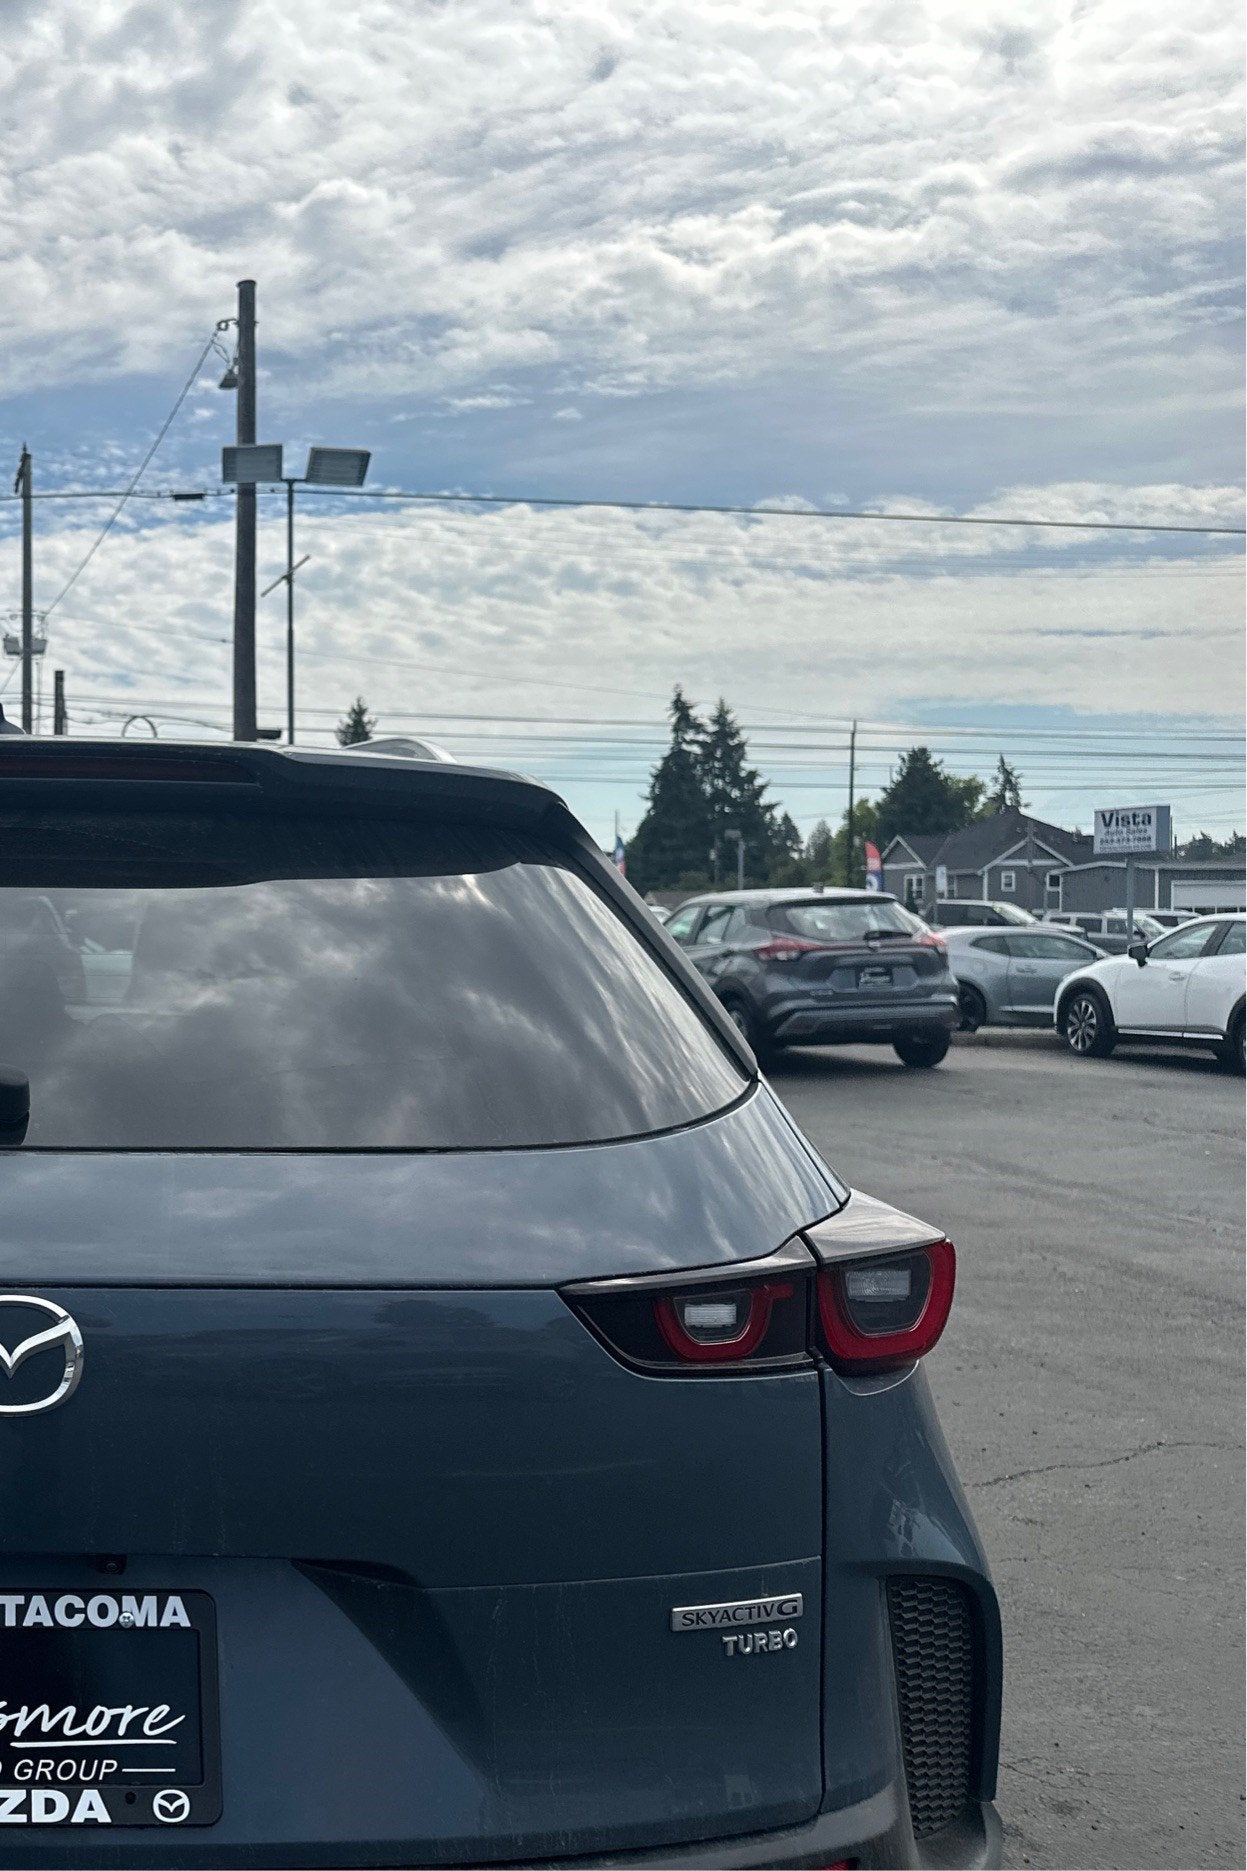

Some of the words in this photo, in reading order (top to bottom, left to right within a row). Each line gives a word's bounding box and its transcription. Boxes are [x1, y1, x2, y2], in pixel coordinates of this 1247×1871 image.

[1100, 811, 1152, 827] Vista
[722, 1627, 798, 1657] TURBO
[13, 1759, 119, 1780] GROUP
